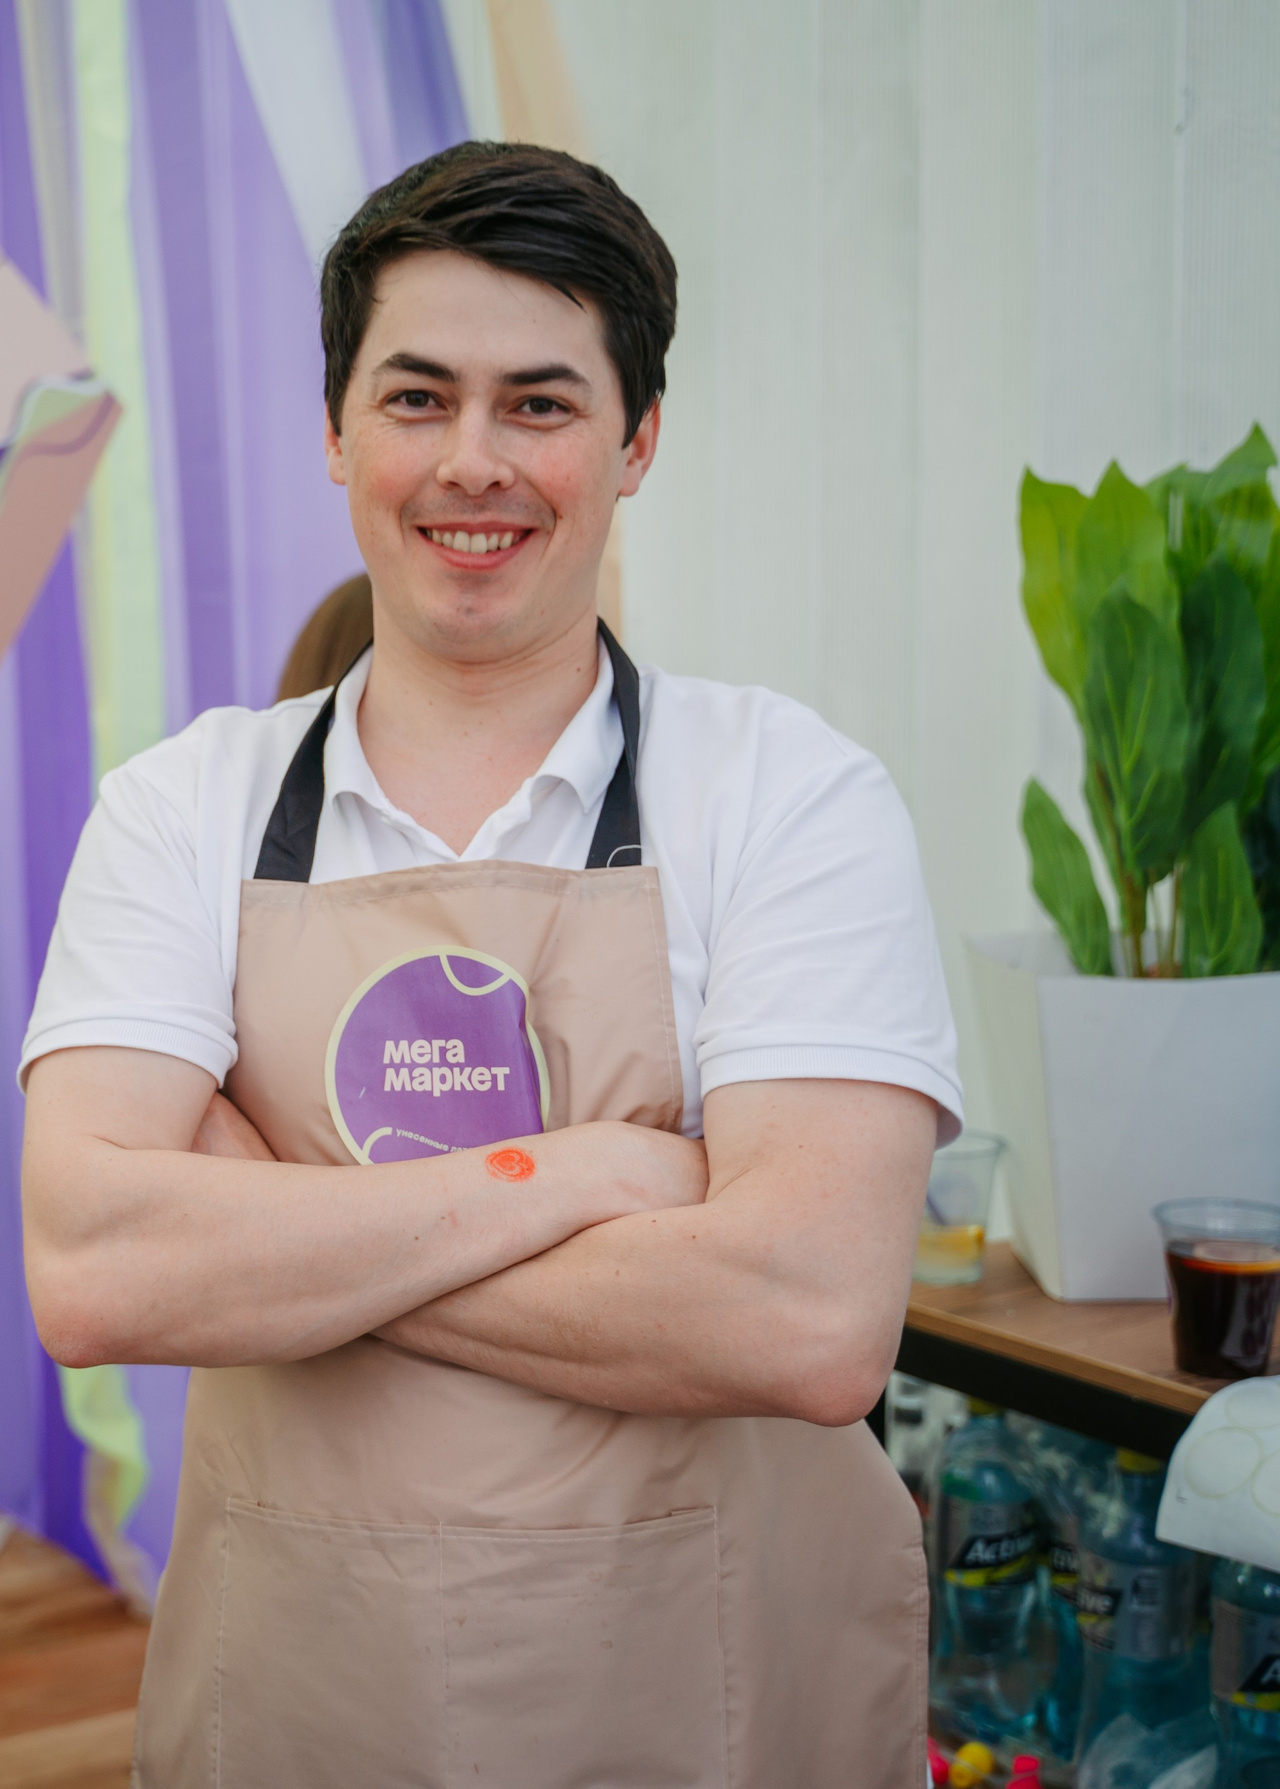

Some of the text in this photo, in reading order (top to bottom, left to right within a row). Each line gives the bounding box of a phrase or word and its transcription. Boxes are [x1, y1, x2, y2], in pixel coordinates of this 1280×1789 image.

[383, 1038, 465, 1064] мега
[383, 1066, 510, 1097] маркет
[396, 1129, 449, 1152] унесенные
